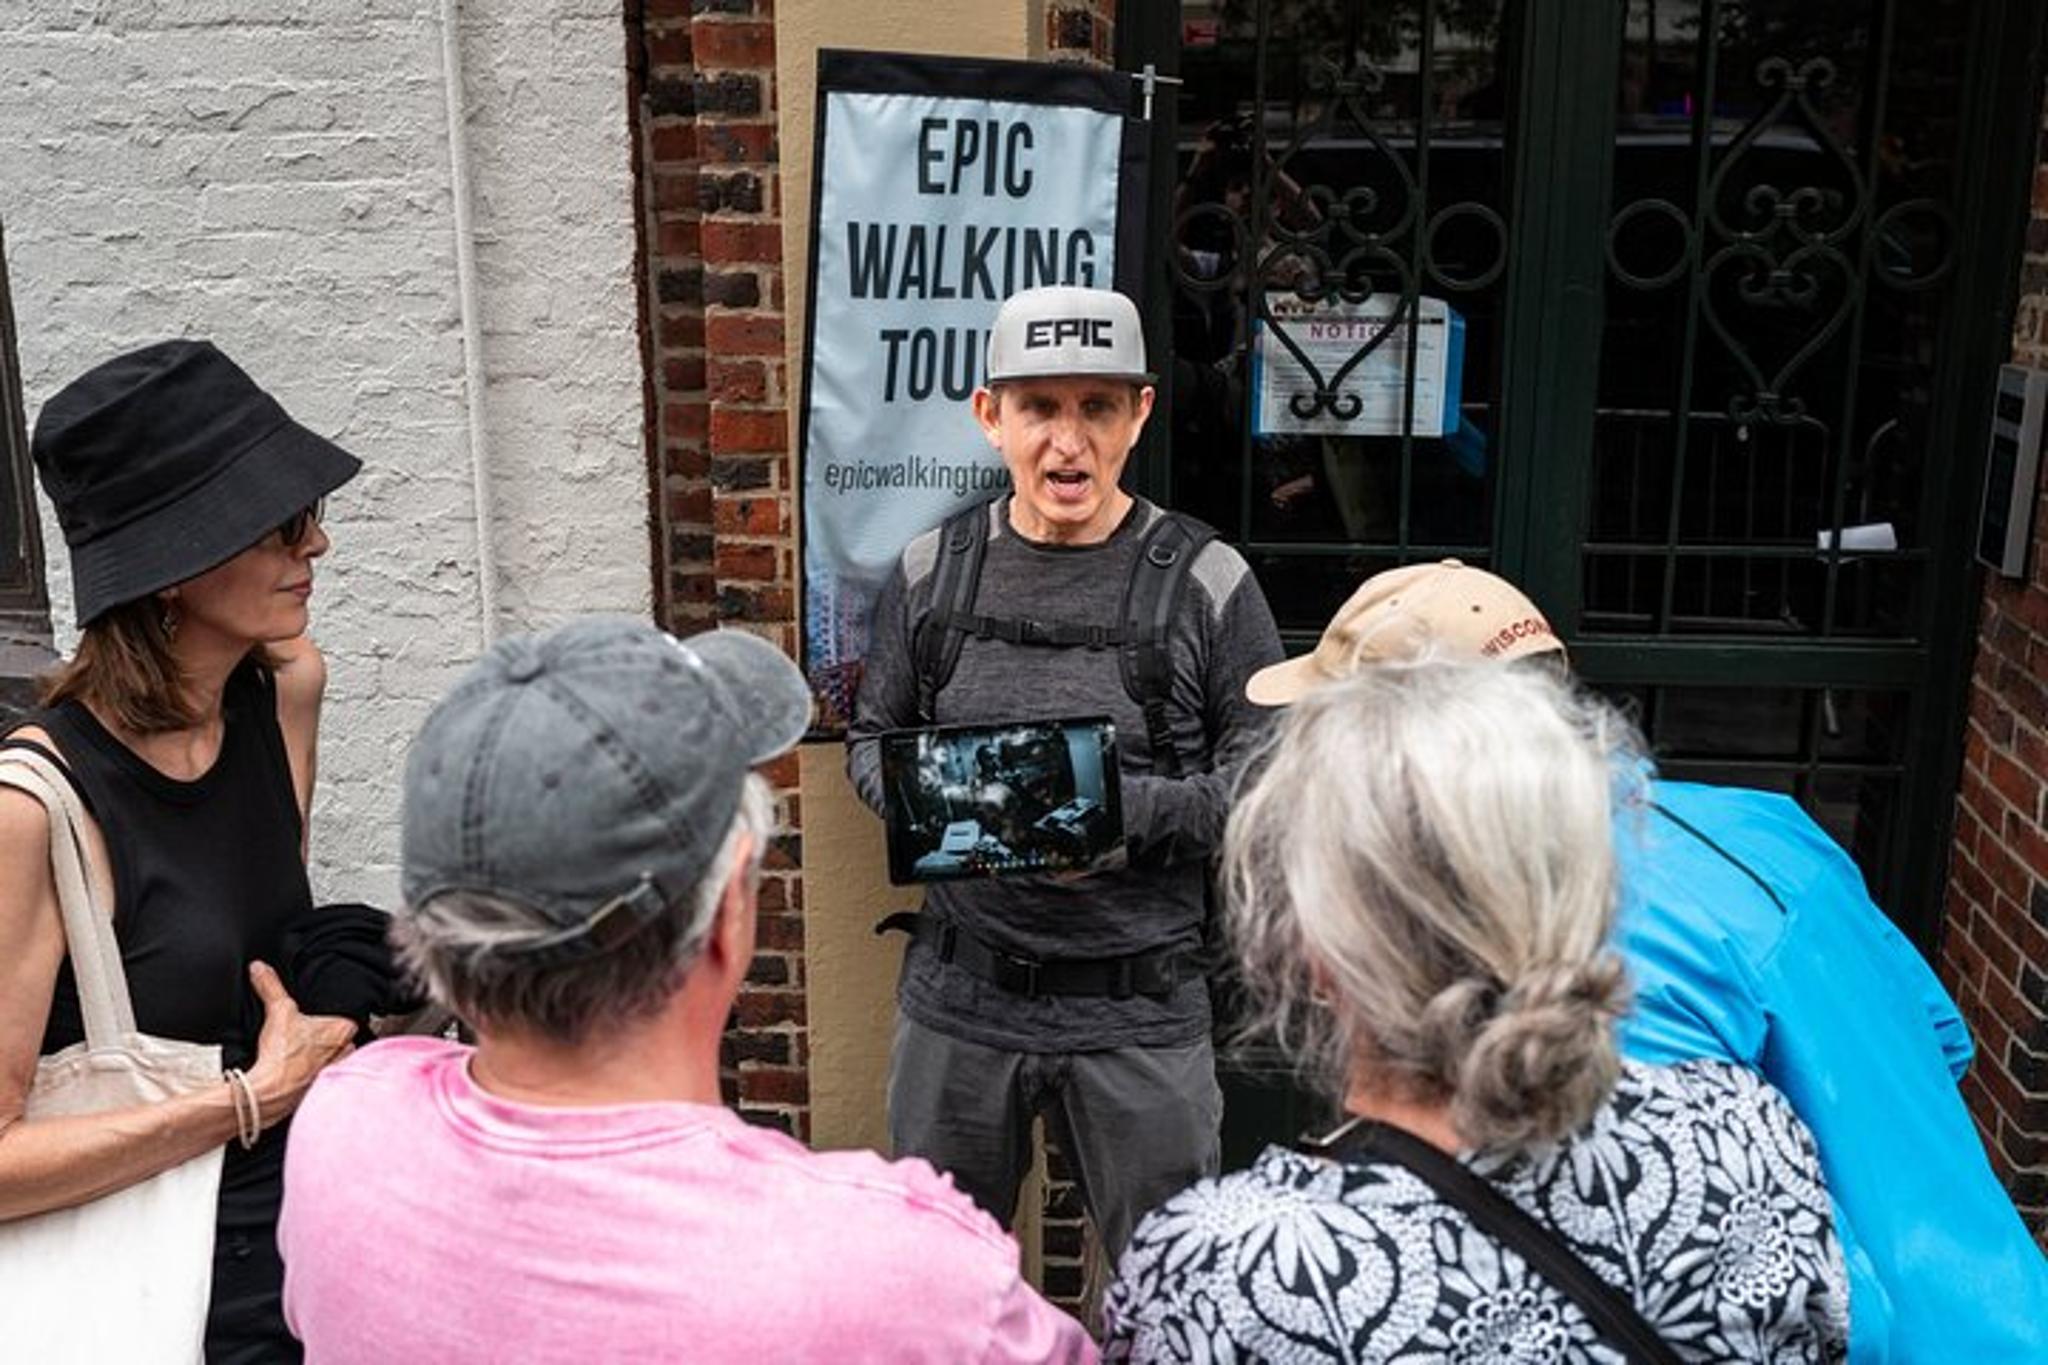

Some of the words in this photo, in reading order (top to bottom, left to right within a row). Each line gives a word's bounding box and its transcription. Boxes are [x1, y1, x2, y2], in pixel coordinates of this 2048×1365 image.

[918, 118, 1034, 199] EPIC
[847, 221, 1095, 300] WALKING
[880, 326, 992, 402] TOU
[1025, 318, 1113, 349] EPIC
[1310, 323, 1383, 339] NOTIC
